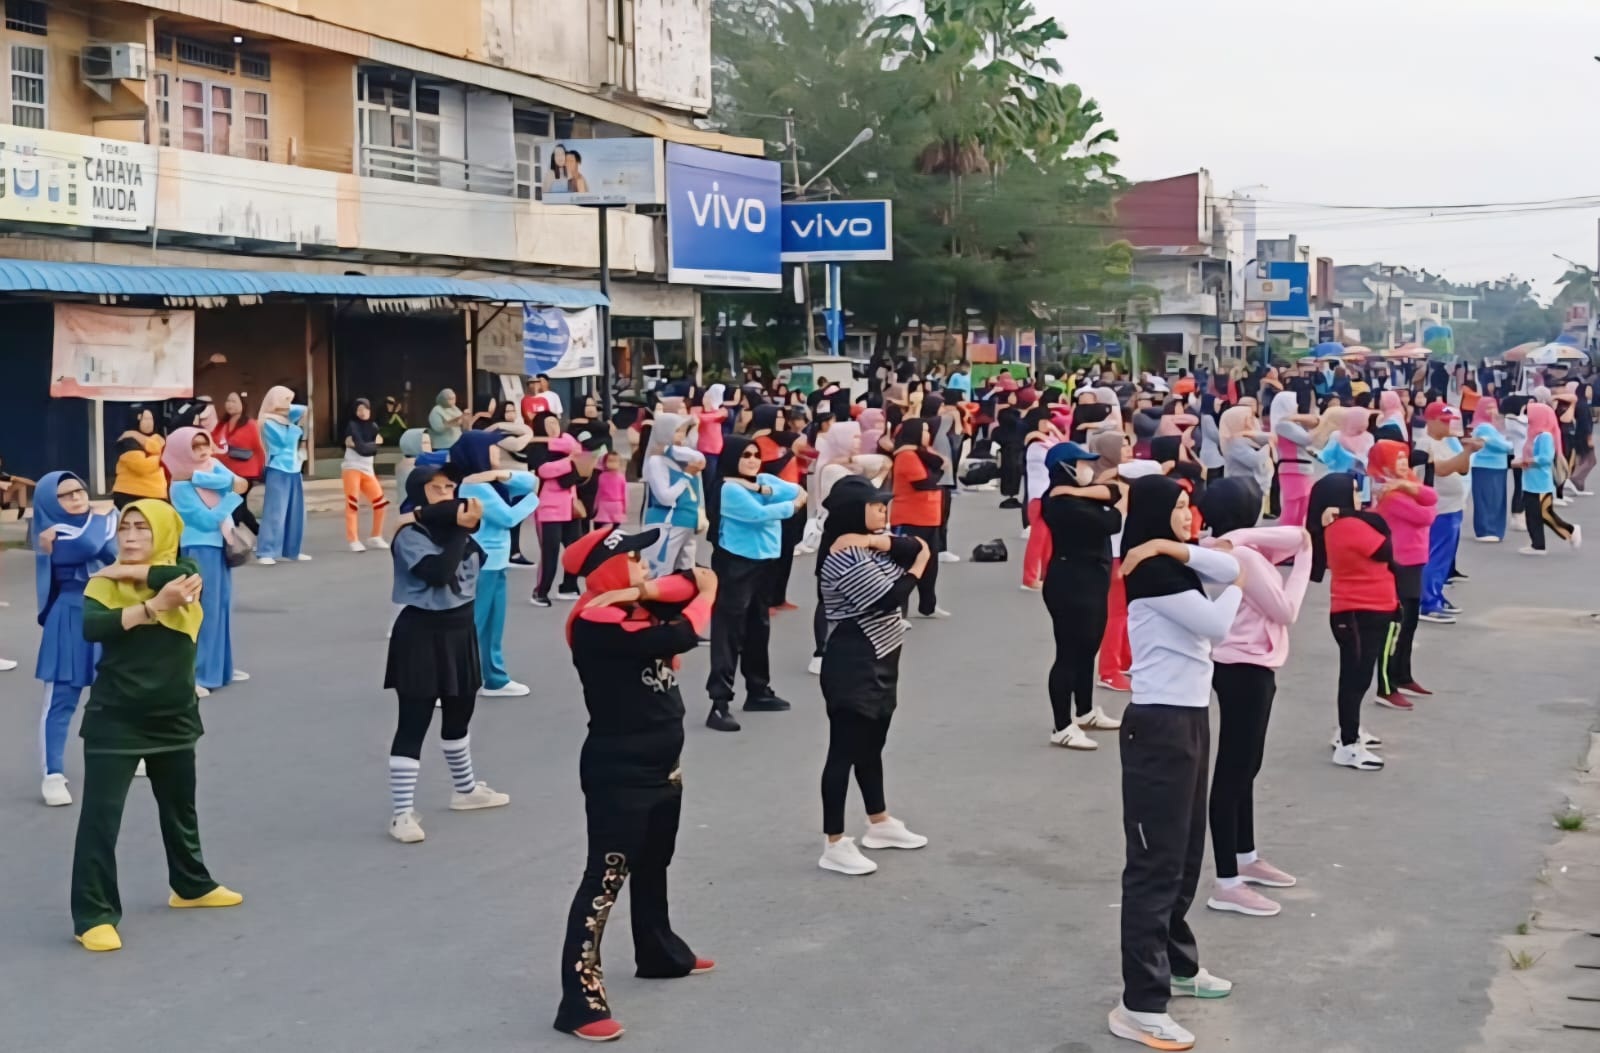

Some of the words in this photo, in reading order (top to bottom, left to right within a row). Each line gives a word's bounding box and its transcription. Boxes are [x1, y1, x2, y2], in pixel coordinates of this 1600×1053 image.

[83, 156, 142, 186] CAHAYA
[93, 186, 136, 212] MUDA
[687, 181, 766, 233] vivo
[791, 213, 872, 238] vivo
